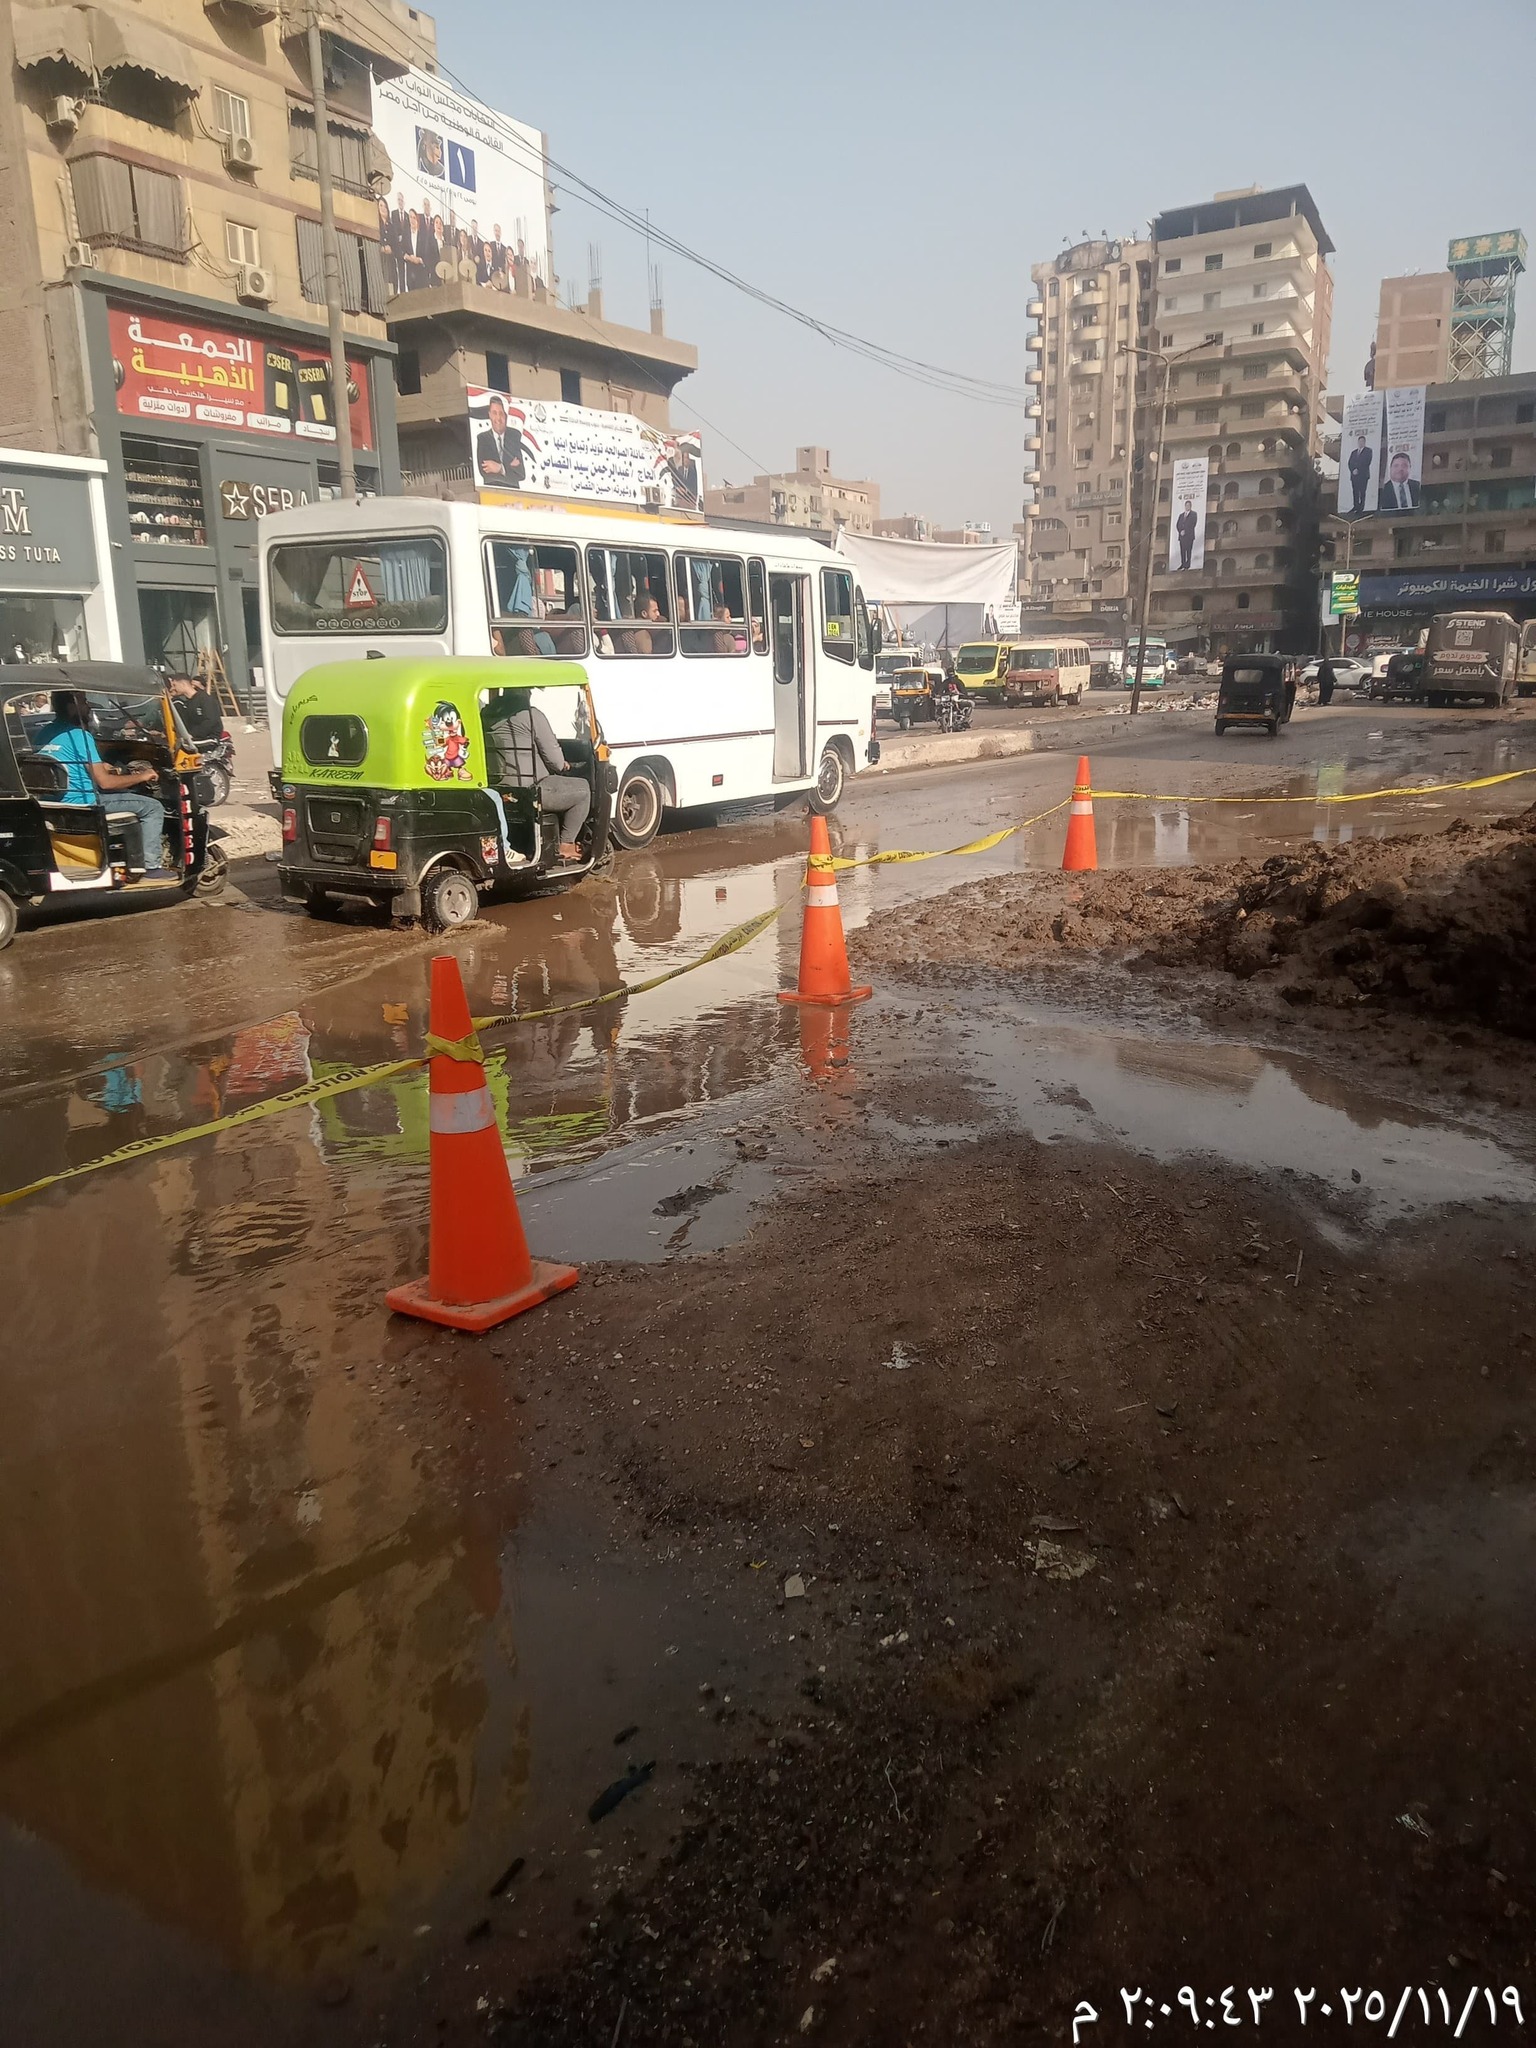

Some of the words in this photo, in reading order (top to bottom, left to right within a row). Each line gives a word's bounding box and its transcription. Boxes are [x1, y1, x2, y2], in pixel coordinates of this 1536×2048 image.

[379, 88, 401, 104] مصر
[406, 80, 432, 99] النواب
[433, 93, 461, 113] مجلس
[422, 108, 440, 122] من
[127, 316, 253, 366] الجمعة
[131, 347, 255, 392] الذهبية
[276, 355, 292, 373] SER
[143, 400, 166, 412] منزلية
[203, 408, 237, 422] مفروشات
[256, 418, 282, 429] مراتب
[303, 425, 330, 436] سجاد
[540, 455, 572, 471] القصاص
[573, 459, 589, 475] سيد
[637, 467, 656, 482] الحاج
[24, 546, 61, 562] TUTA
[1397, 580, 1447, 596] للكمبيوتر
[1450, 578, 1489, 593] الخيمة
[1494, 575, 1518, 593] شبرا
[1376, 610, 1413, 618] HOUSE
[1456, 619, 1486, 627] STENG
[1460, 653, 1483, 661] هدوم
[1433, 667, 1454, 676] سعر
[1455, 665, 1485, 677] بأفضل
[308, 768, 364, 781] KAREEM
[276, 1069, 368, 1103] CAUTION
